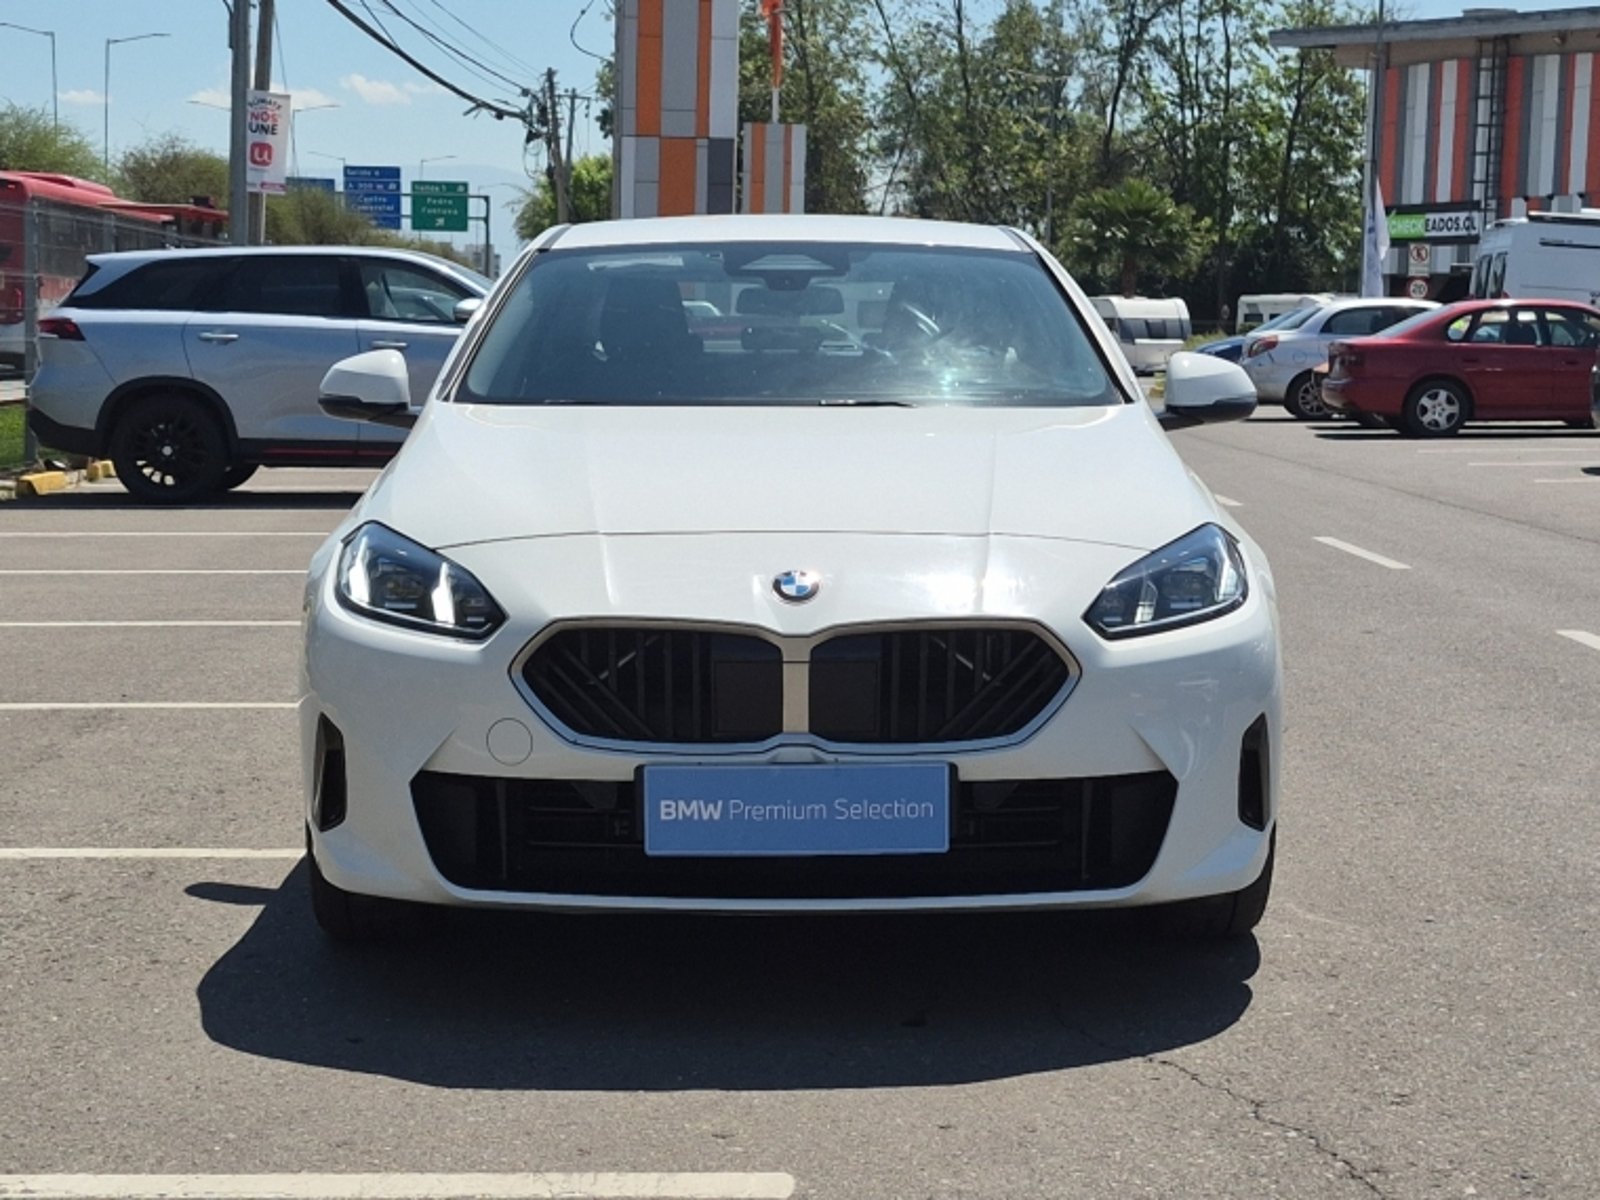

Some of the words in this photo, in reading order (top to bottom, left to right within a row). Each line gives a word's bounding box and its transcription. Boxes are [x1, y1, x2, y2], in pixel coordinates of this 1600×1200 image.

[250, 111, 278, 123] NOS
[248, 123, 278, 136] UNE
[660, 800, 723, 820] BMW
[729, 798, 827, 820] Premium
[834, 798, 934, 820] Selection
